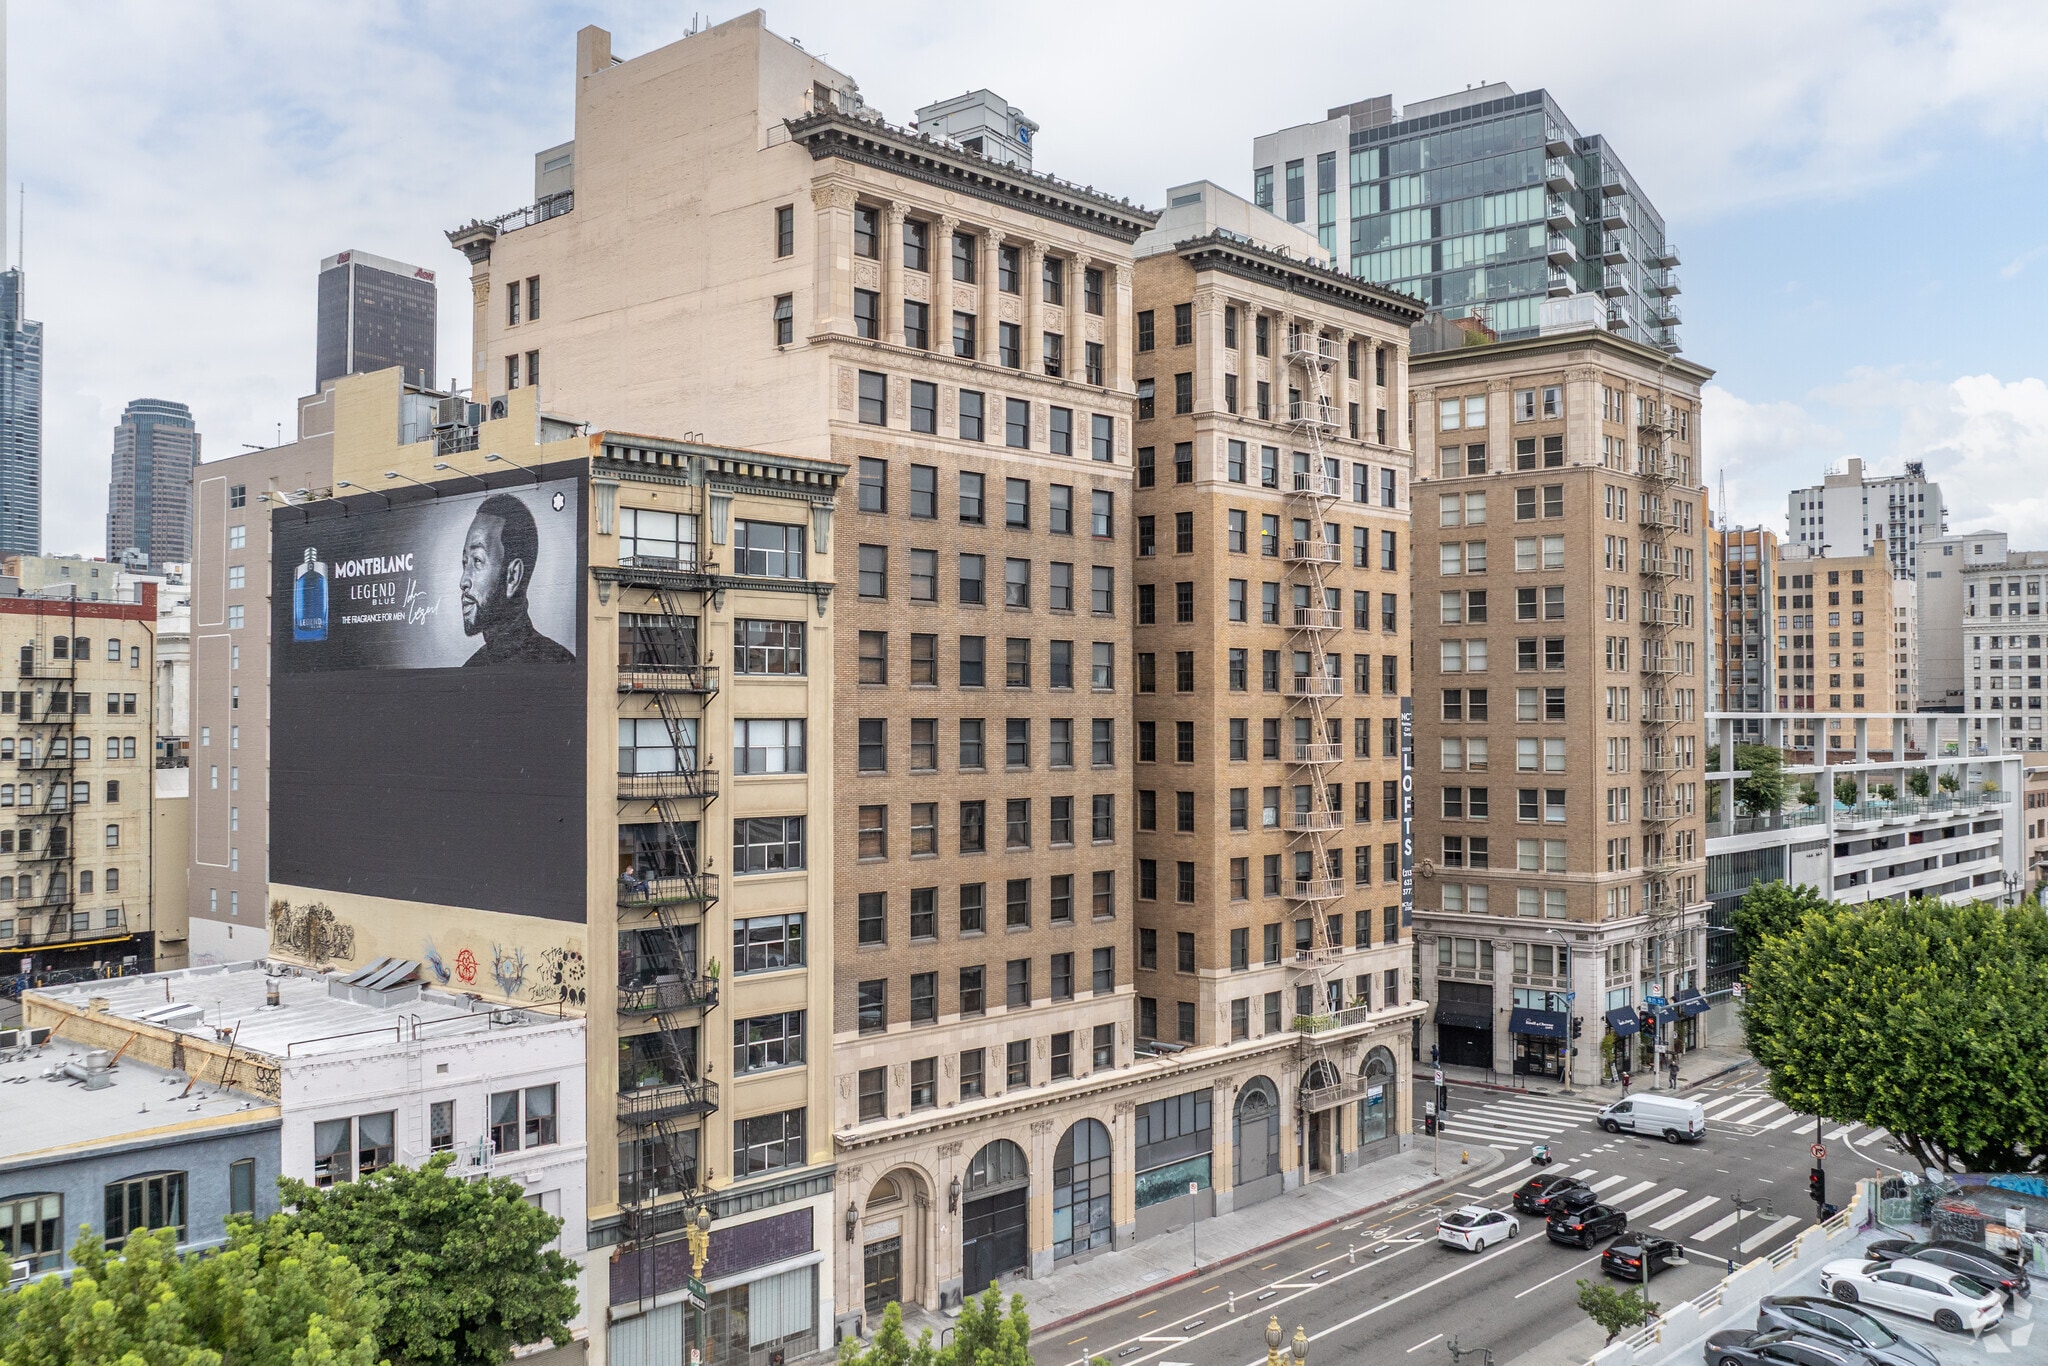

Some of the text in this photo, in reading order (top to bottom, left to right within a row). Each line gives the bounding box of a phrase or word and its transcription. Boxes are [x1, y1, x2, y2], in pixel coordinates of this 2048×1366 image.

[335, 553, 414, 579] MONTBLANC
[351, 582, 396, 600] LEGEND
[372, 597, 396, 606] BLUE
[342, 611, 405, 624] THE FRAGRANCE FOR MEN
[1402, 753, 1412, 856] LOFTS
